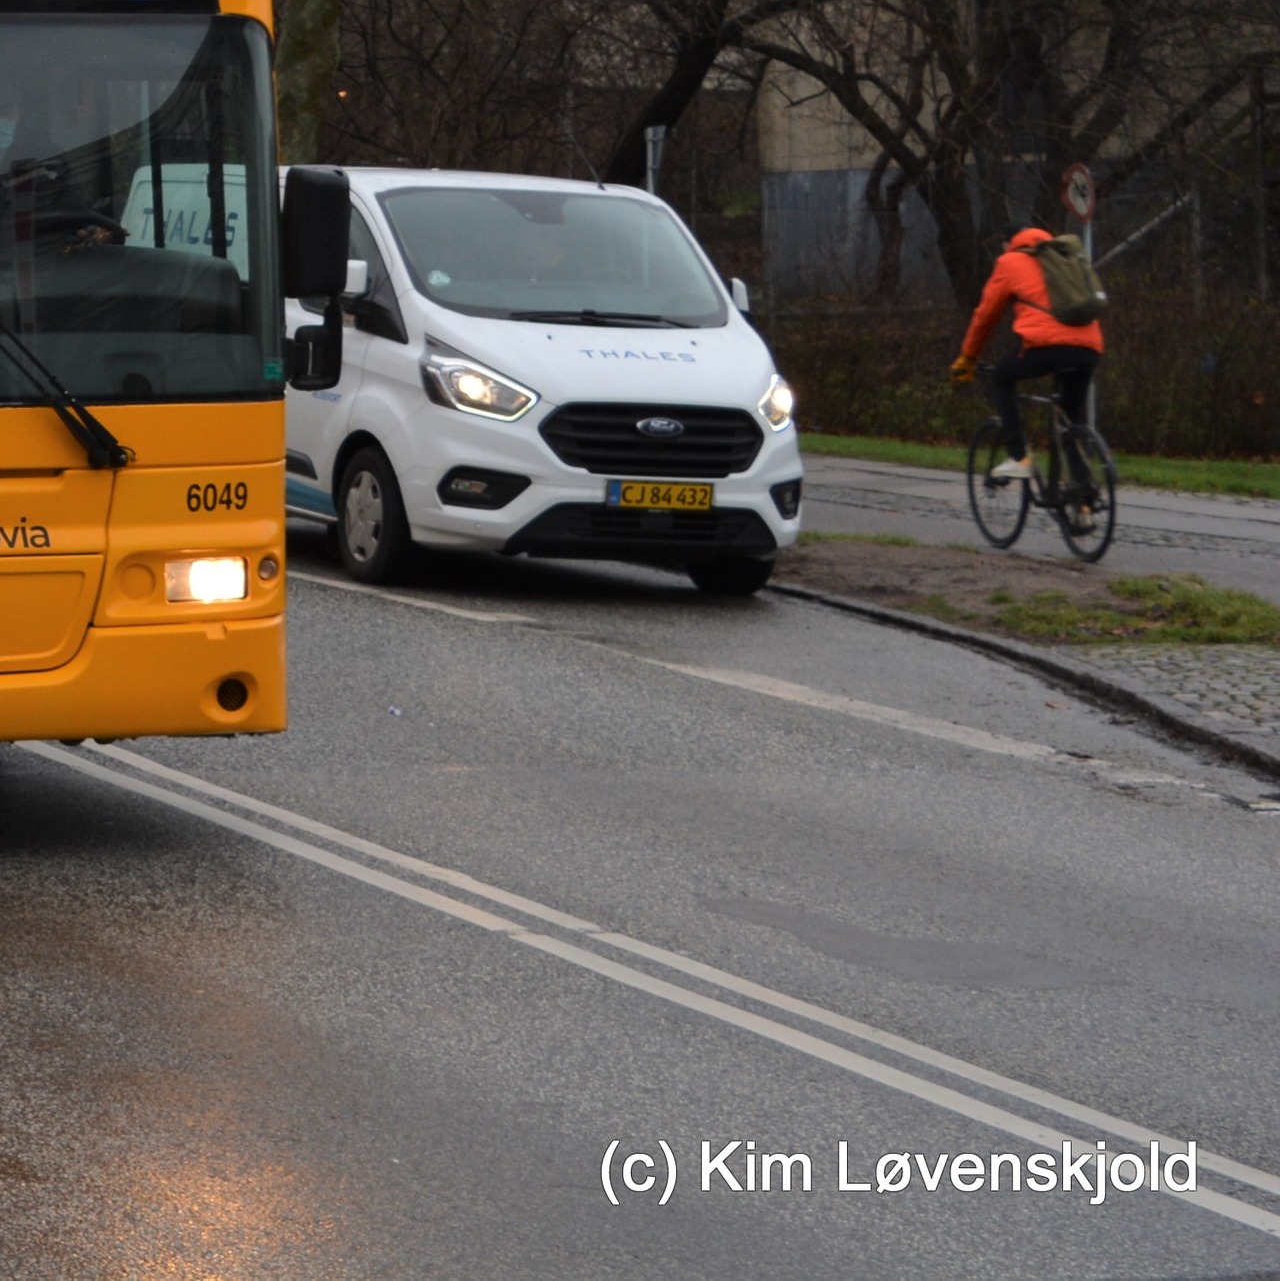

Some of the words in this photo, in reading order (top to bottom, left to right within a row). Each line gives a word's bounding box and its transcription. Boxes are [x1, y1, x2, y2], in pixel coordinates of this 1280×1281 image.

[578, 349, 696, 362] THALES
[187, 481, 248, 512] 6049
[622, 485, 645, 504] CJ
[650, 486, 672, 505] 84
[676, 487, 709, 506] 432
